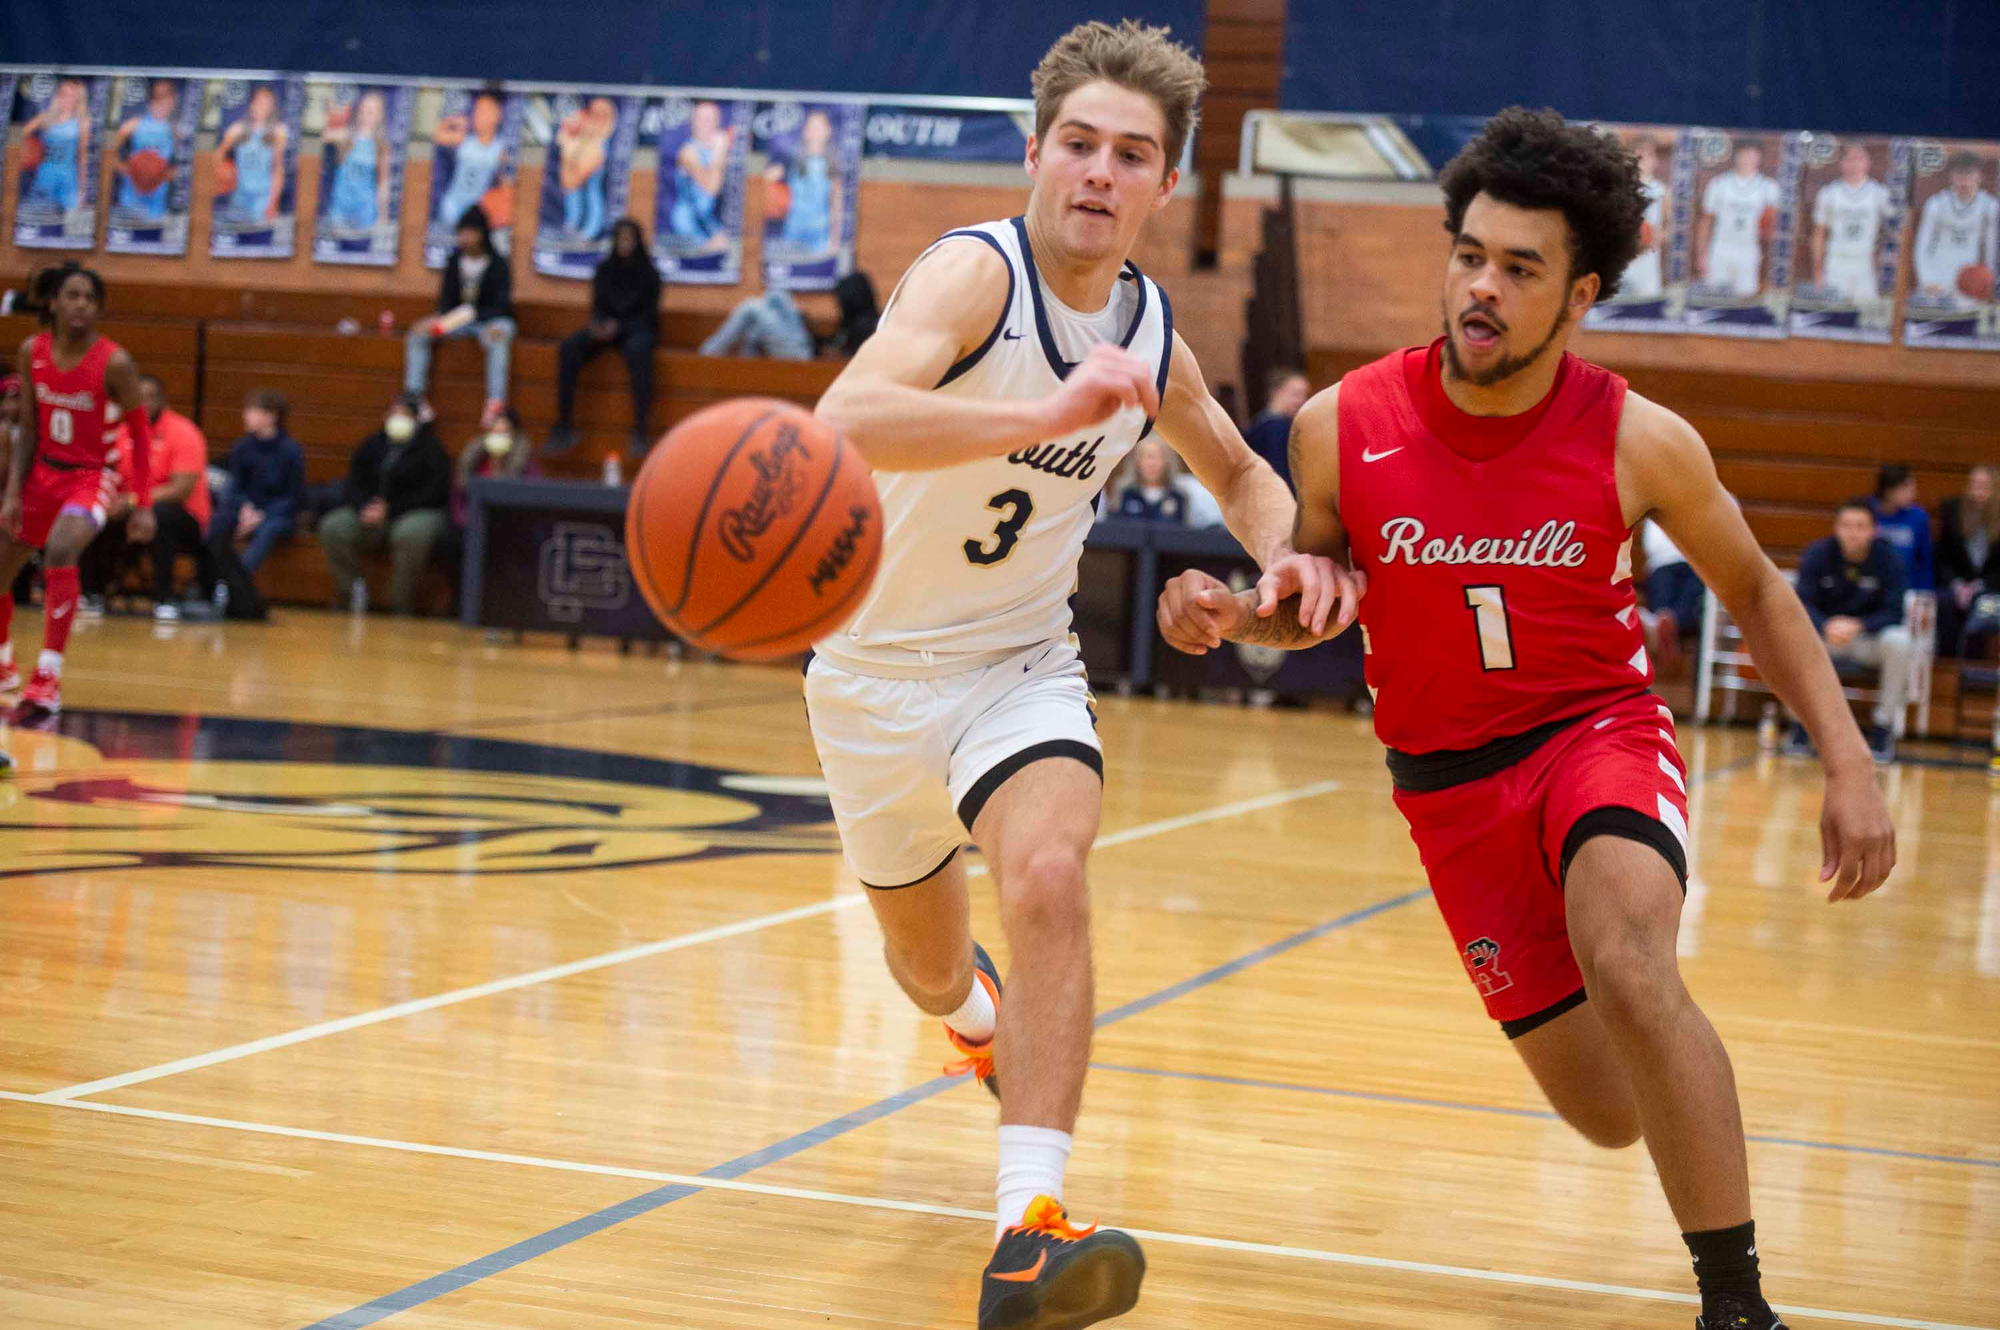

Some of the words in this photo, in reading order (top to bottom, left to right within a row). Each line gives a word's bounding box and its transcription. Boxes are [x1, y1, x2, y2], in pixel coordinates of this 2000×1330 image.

[49, 408, 74, 445] 0
[1007, 435, 1105, 480] outh
[961, 487, 1036, 569] 3
[1377, 516, 1587, 568] Roseville
[1462, 583, 1517, 673] 1
